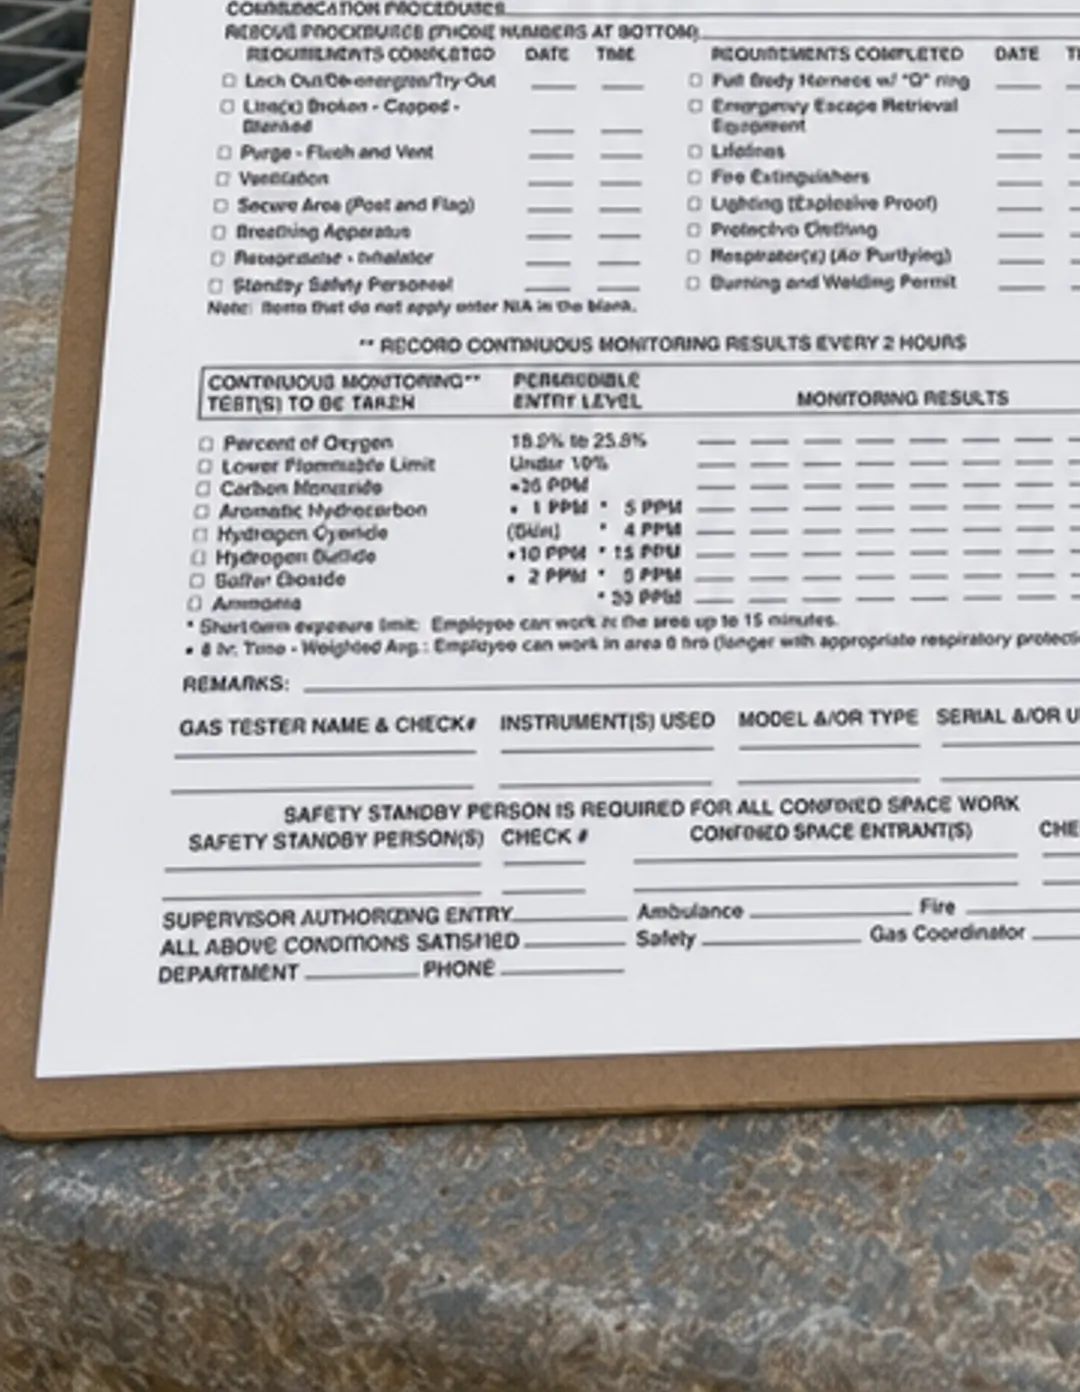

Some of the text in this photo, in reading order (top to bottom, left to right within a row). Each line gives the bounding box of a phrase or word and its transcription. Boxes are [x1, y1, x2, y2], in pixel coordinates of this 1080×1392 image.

[525, 47, 570, 61] DATE
[995, 46, 1040, 61] DATE
[936, 74, 971, 91] ring
[359, 145, 434, 159] and Vent
[302, 197, 475, 213] Area and Flag)
[883, 196, 938, 214] Proof)
[786, 275, 956, 291] and Permit
[375, 300, 499, 315] not apply enter
[380, 336, 967, 354] RECORD CONTINUOUS MONITORING RESULTS EVERY 2 HOURS
[290, 396, 313, 413] TO
[797, 391, 1010, 407] MONITORING RESULTS
[223, 435, 317, 454] Percent of
[222, 458, 436, 475] Lower Limit
[220, 481, 288, 496] Carbon
[548, 499, 589, 514] PPM
[641, 499, 683, 514] PPM
[641, 523, 682, 536] PPM
[546, 546, 586, 561] PPM
[546, 568, 586, 584] PPM
[520, 612, 839, 632] can work up 15 minutes.
[522, 639, 553, 654] can
[603, 638, 619, 652] in
[820, 632, 916, 650] appropriate
[921, 630, 1010, 649] respiratory
[183, 675, 290, 693] REMARKS:
[500, 711, 715, 732] INSTRUMENT(S) USED
[738, 710, 807, 727] MODEL
[869, 710, 919, 727] TYPE
[936, 708, 1006, 725] SERIAL
[179, 716, 476, 736] GAS TESTER NAME & CHECK#
[284, 796, 1020, 824] SAFETY STANDBY PERSON IS REQUIRED FOR ALL SPACE WORK
[189, 830, 485, 851] SAFETY STANDBY PERSON(S)
[500, 828, 571, 846] CHECK
[794, 822, 973, 842] SPACE ENTRANT(S)
[637, 902, 745, 922] Ambulance
[920, 898, 956, 915] Fire
[163, 906, 514, 930] SUPERVISOR ENTRY
[636, 929, 697, 950] Safety
[870, 924, 1026, 944] Gas Coordinator
[160, 939, 199, 957] ALL
[205, 937, 277, 956] ABOVE
[159, 963, 299, 984] DEPARTMENT
[423, 959, 495, 979] PHONE
